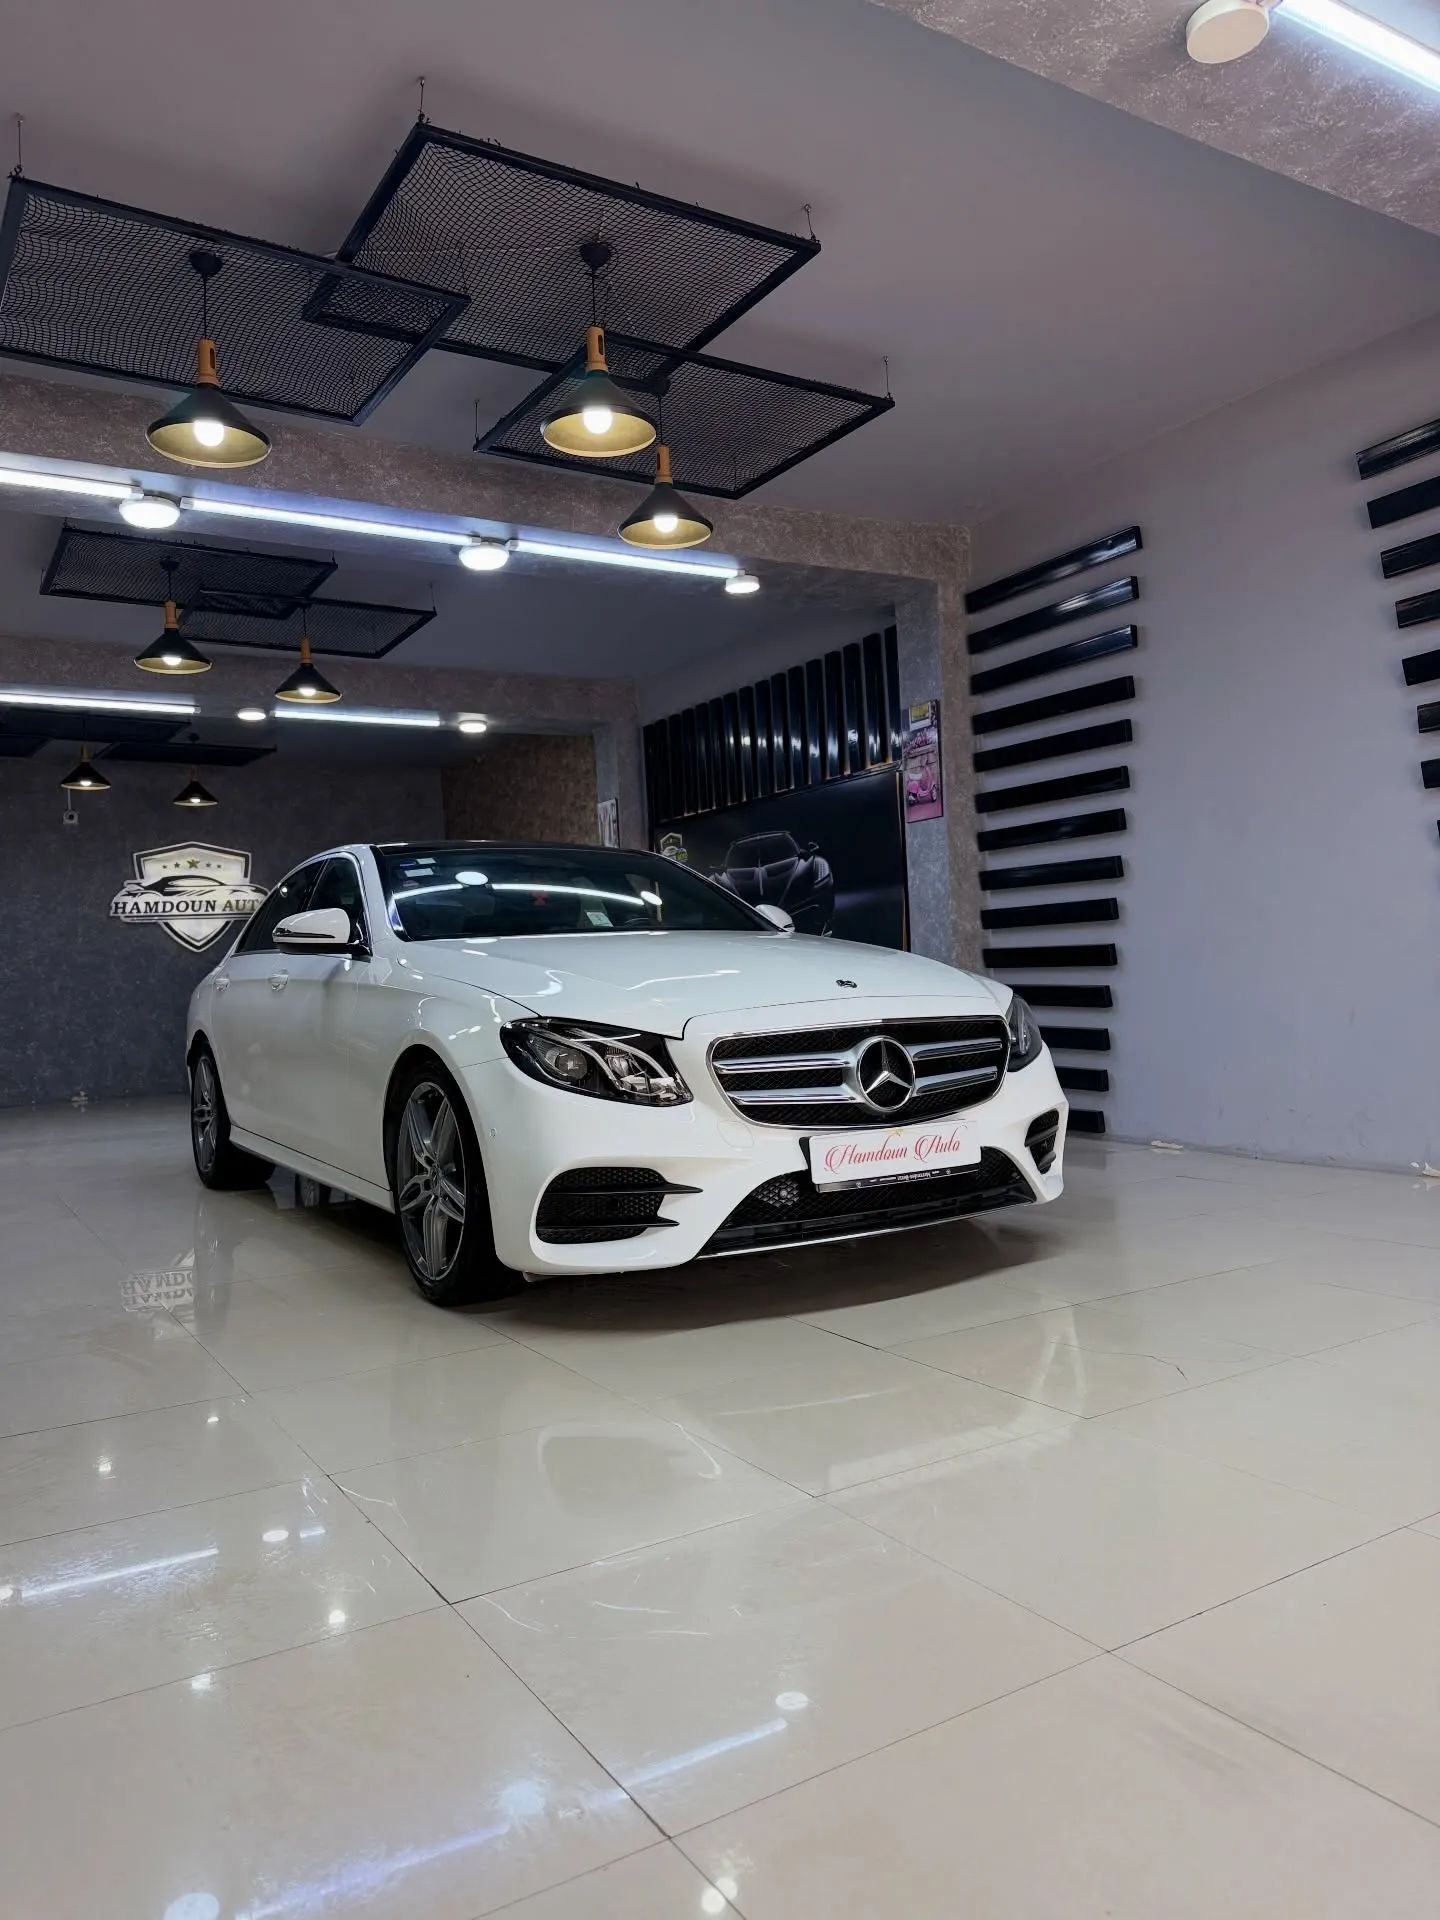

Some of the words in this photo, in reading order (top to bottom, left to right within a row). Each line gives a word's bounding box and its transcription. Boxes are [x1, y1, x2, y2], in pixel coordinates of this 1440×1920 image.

[112, 899, 217, 915] HAMDOUN
[222, 899, 262, 912] AUT
[824, 1133, 908, 1175] Hamdoun
[913, 1125, 968, 1164] Auto
